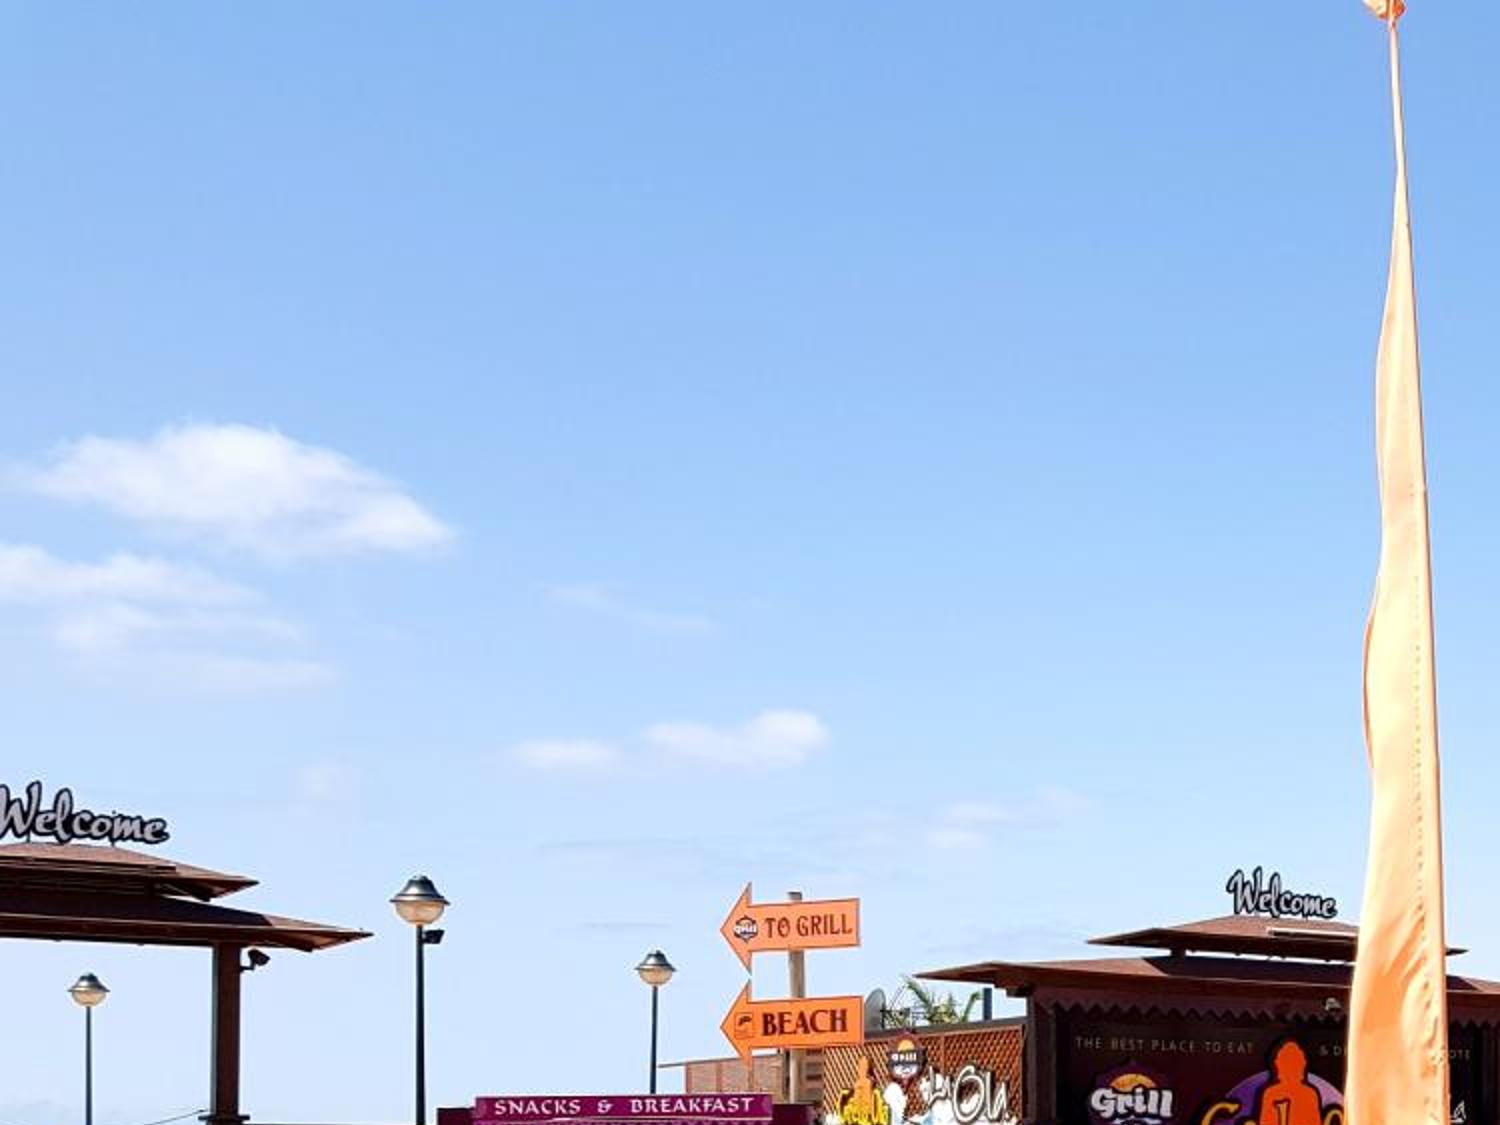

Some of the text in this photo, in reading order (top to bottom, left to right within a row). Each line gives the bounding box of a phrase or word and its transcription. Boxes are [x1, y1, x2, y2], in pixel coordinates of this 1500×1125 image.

[0, 780, 170, 845] Welcome
[1226, 866, 1338, 918] Welcome
[765, 914, 853, 938] TO GRILL
[762, 1009, 848, 1037] BEACH
[1075, 1037, 1102, 1049] THE
[1111, 1038, 1144, 1050] BEST
[1151, 1039, 1194, 1052] PLACE
[1205, 1041, 1222, 1053] TO
[1227, 1042, 1254, 1053] EAT
[494, 1097, 755, 1116] SNACKS & BREAKFAST
[1091, 1086, 1174, 1119] Grill
